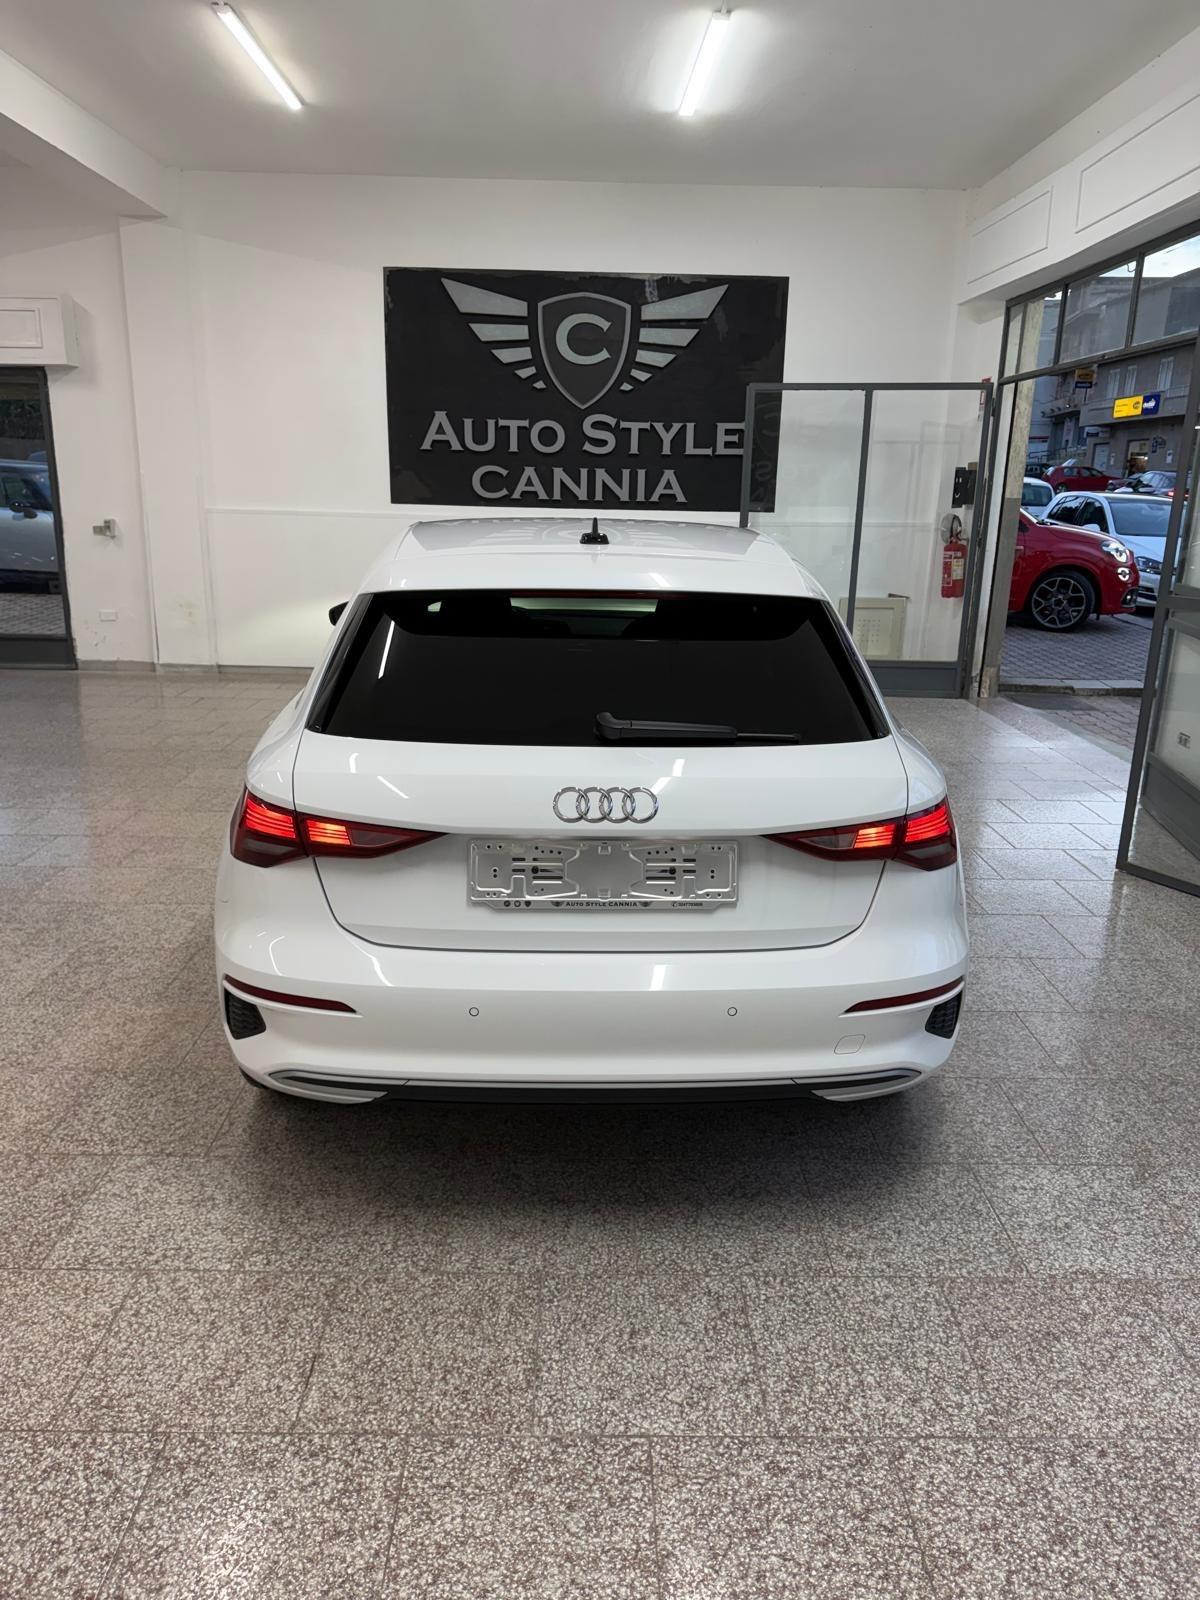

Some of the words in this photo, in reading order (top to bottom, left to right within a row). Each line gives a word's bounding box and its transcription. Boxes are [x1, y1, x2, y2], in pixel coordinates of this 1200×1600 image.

[556, 313, 612, 365] C
[420, 411, 565, 453] AUTO
[582, 414, 745, 456] STYLE
[472, 465, 687, 503] CANNIA
